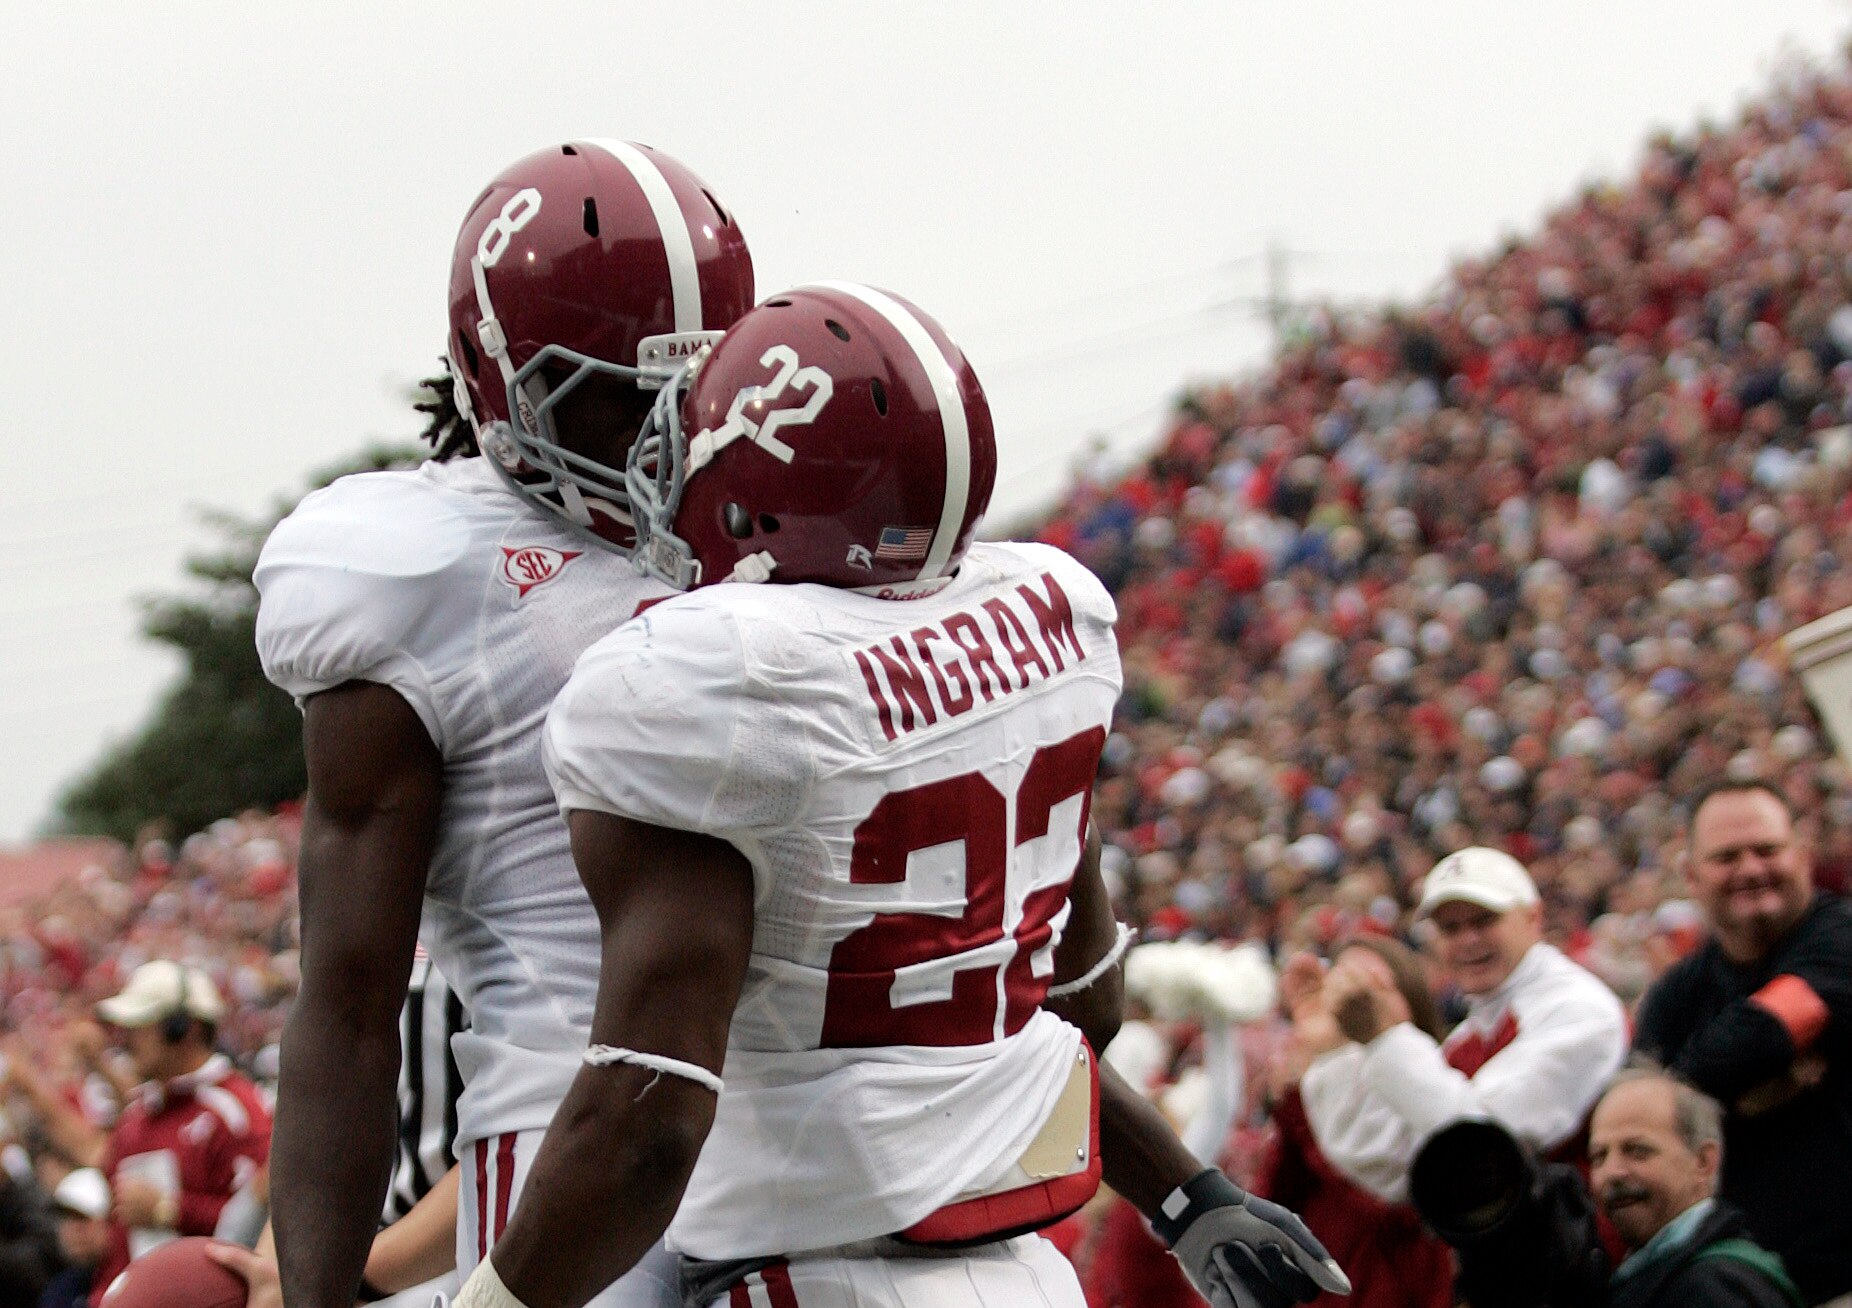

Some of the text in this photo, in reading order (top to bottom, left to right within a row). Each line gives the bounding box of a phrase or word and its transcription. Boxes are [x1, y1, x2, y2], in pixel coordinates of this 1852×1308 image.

[477, 188, 542, 269] 8
[725, 344, 833, 464] 22
[516, 550, 552, 580] SEC
[854, 571, 1086, 742] INGRAM
[820, 724, 1106, 1048] 22
